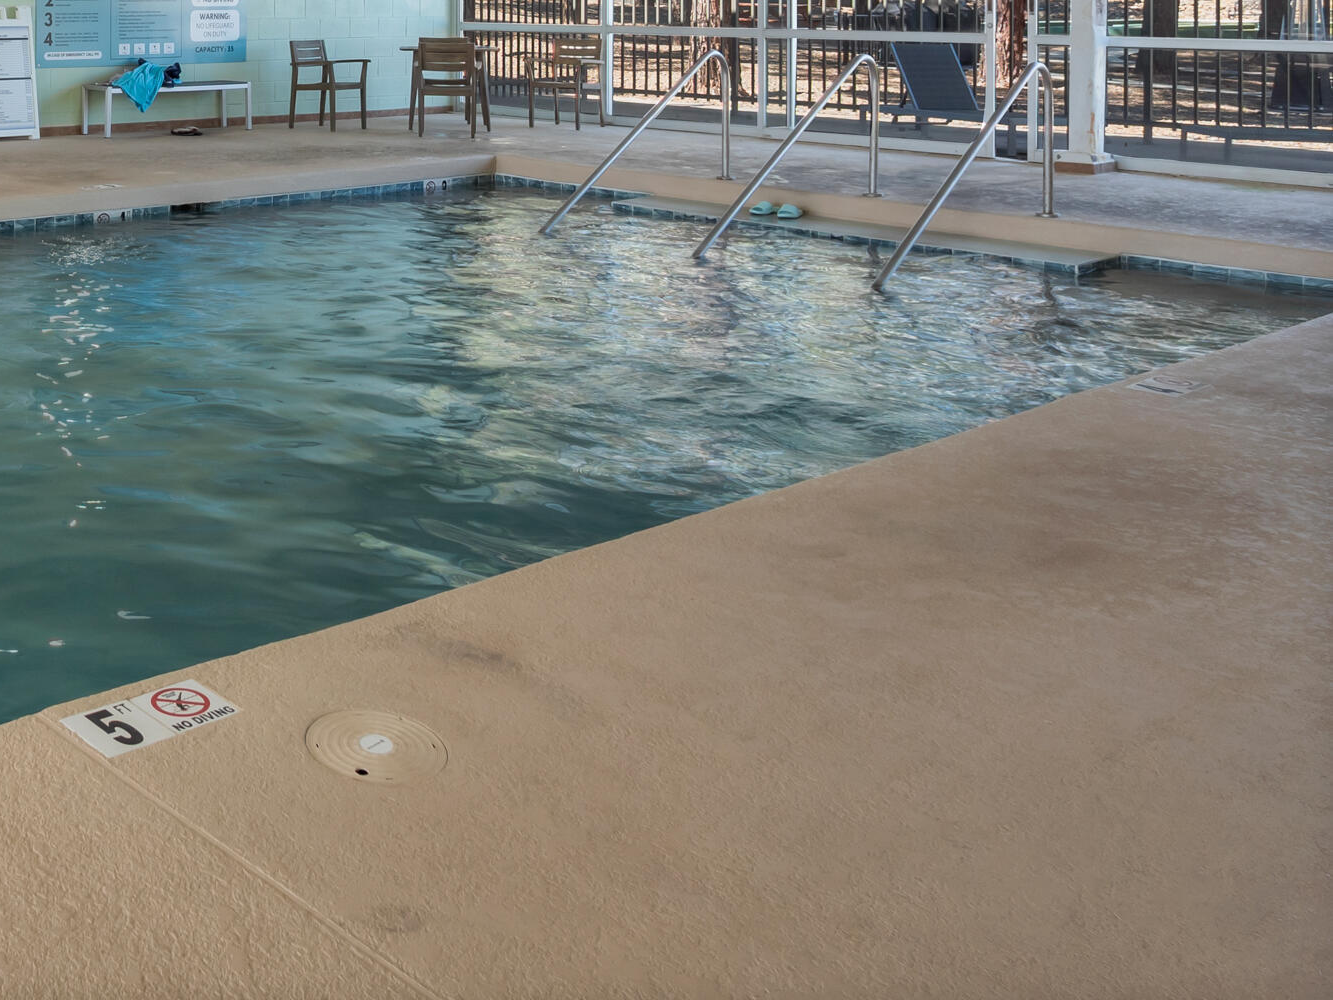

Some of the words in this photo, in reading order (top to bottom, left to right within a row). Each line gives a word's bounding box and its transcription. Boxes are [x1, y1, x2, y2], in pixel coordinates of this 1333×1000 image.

[44, 12, 53, 27] 3
[199, 12, 231, 20] WARNING:
[43, 31, 53, 46] 4
[113, 703, 132, 714] FT
[171, 719, 193, 731] NO
[192, 705, 236, 726] DIVING
[84, 709, 144, 745] 5
